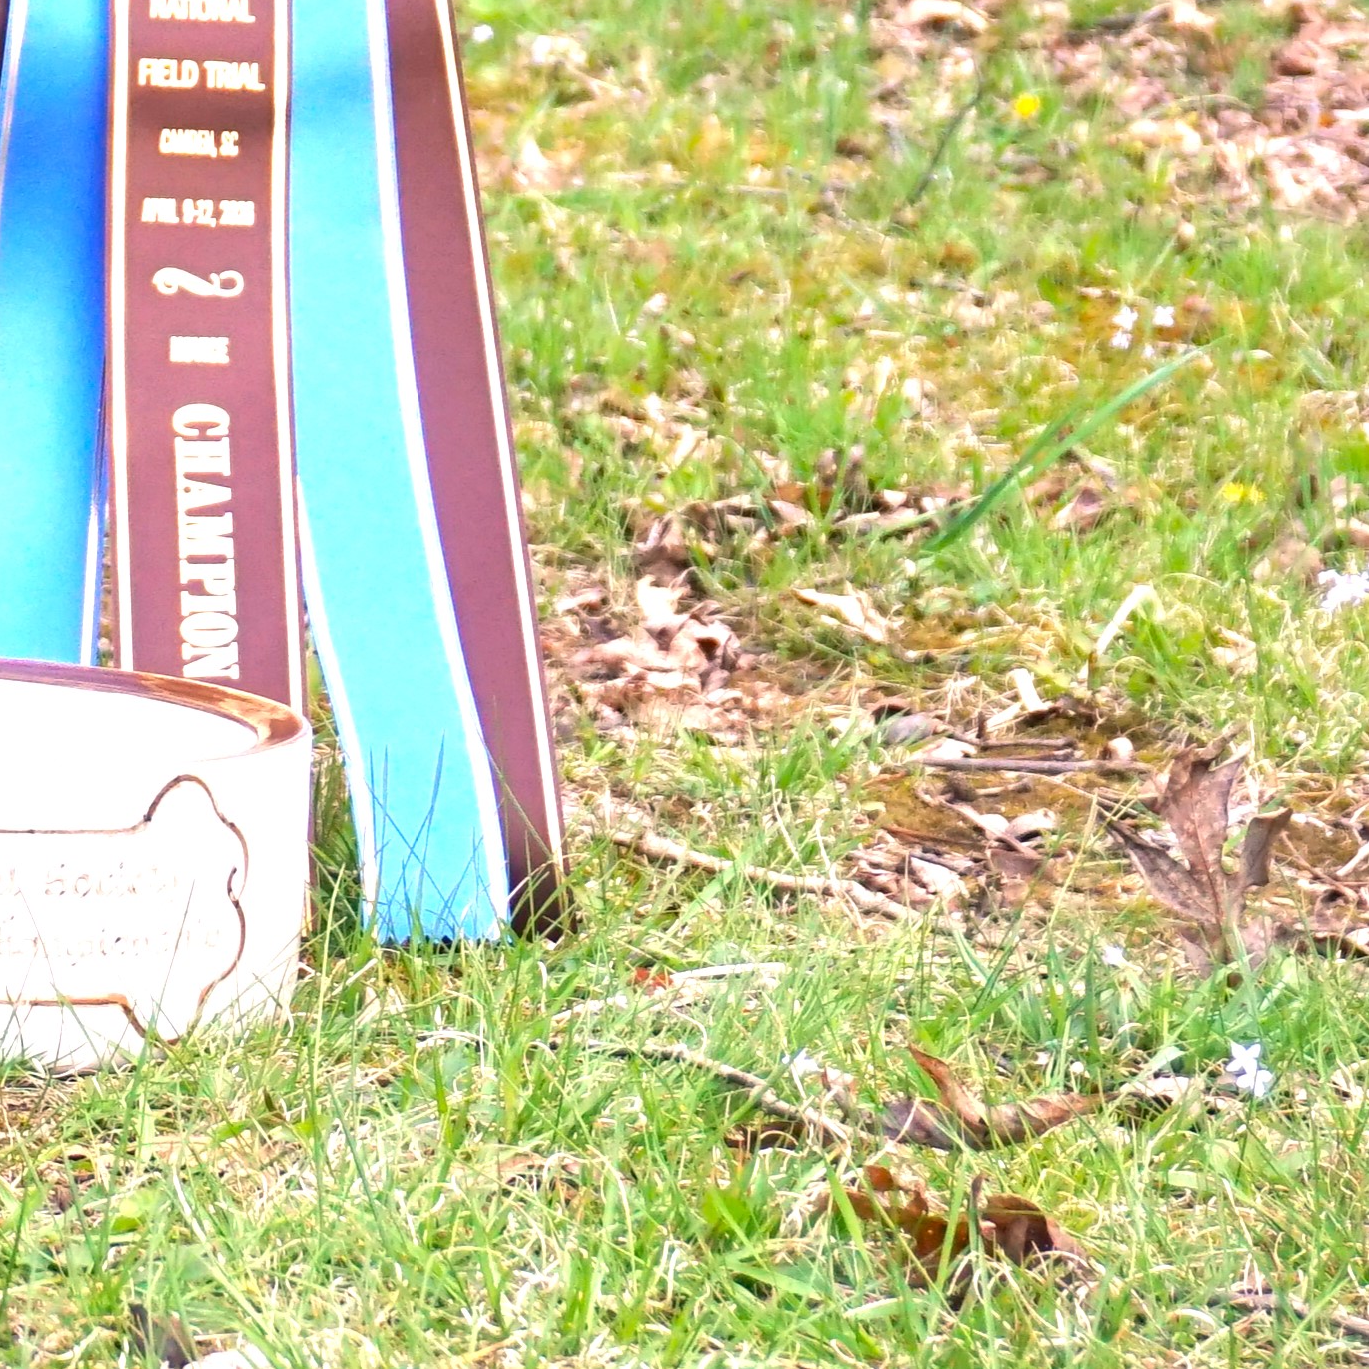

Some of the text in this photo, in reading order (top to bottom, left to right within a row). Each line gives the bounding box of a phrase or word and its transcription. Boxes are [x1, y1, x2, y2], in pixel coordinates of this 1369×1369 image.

[138, 57, 266, 91] FIELD TRIAL
[172, 402, 241, 682] CHAMPION
